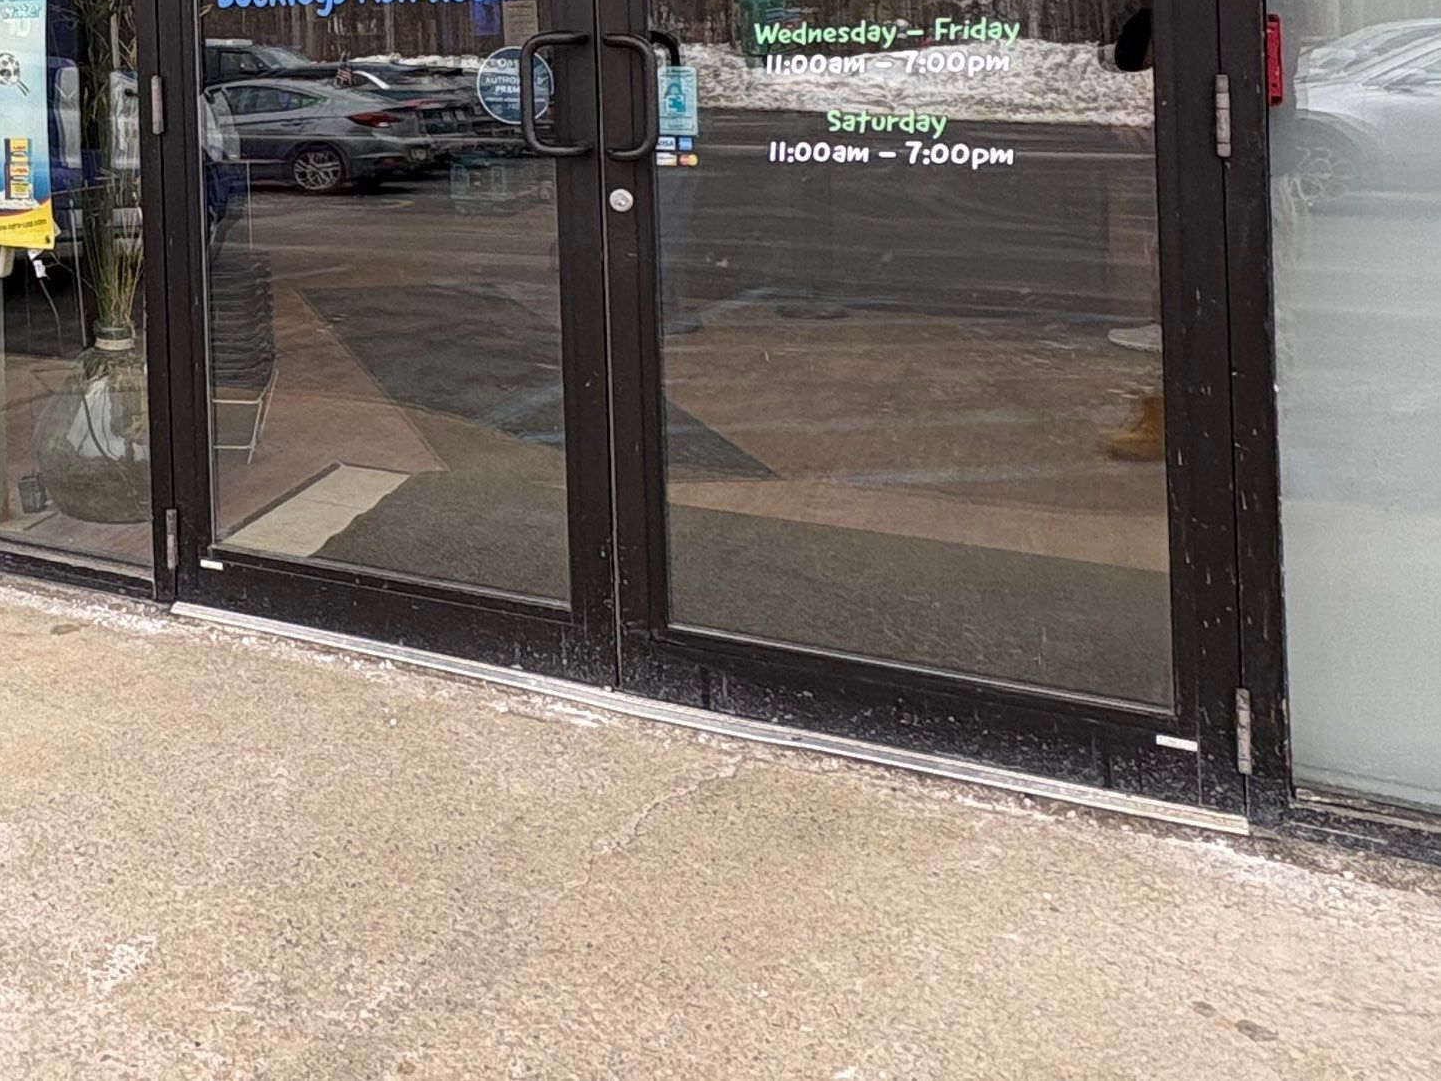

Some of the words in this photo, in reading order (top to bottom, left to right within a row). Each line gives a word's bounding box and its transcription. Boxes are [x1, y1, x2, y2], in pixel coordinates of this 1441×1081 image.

[753, 21, 898, 48] Wednesday
[934, 17, 1022, 46] Friday
[765, 52, 866, 75] 11:00am
[903, 50, 1011, 78] 7:00pm
[826, 109, 947, 138] Saturday
[768, 140, 870, 164] 11:00am
[905, 141, 1015, 171] 7:00pm
